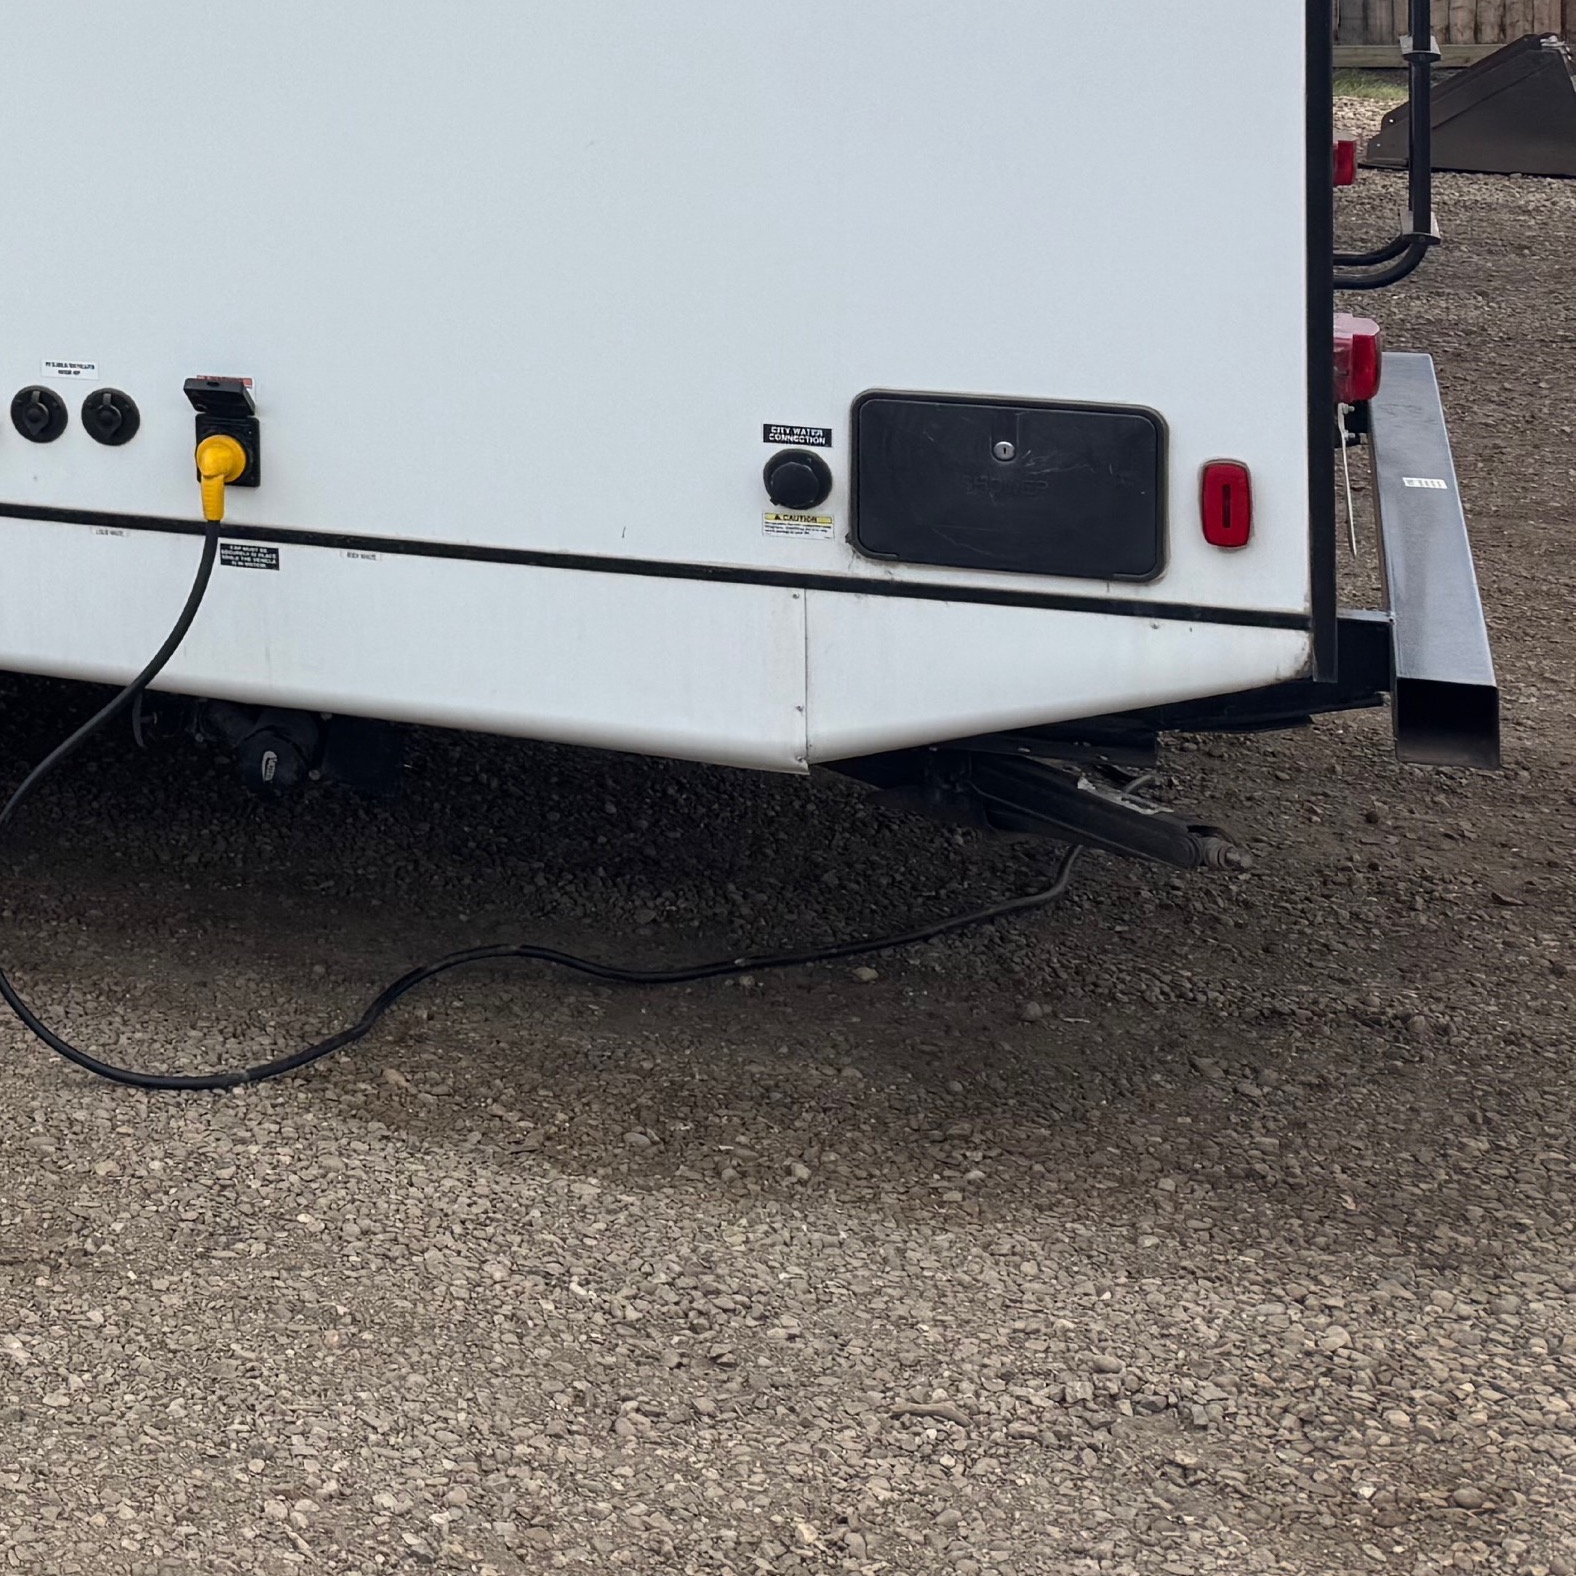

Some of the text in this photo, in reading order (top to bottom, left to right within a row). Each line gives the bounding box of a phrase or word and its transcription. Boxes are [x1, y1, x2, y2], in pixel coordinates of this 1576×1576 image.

[770, 426, 791, 434] CITY
[768, 433, 826, 445] CONNECTION
[782, 514, 818, 523] CAUTION
